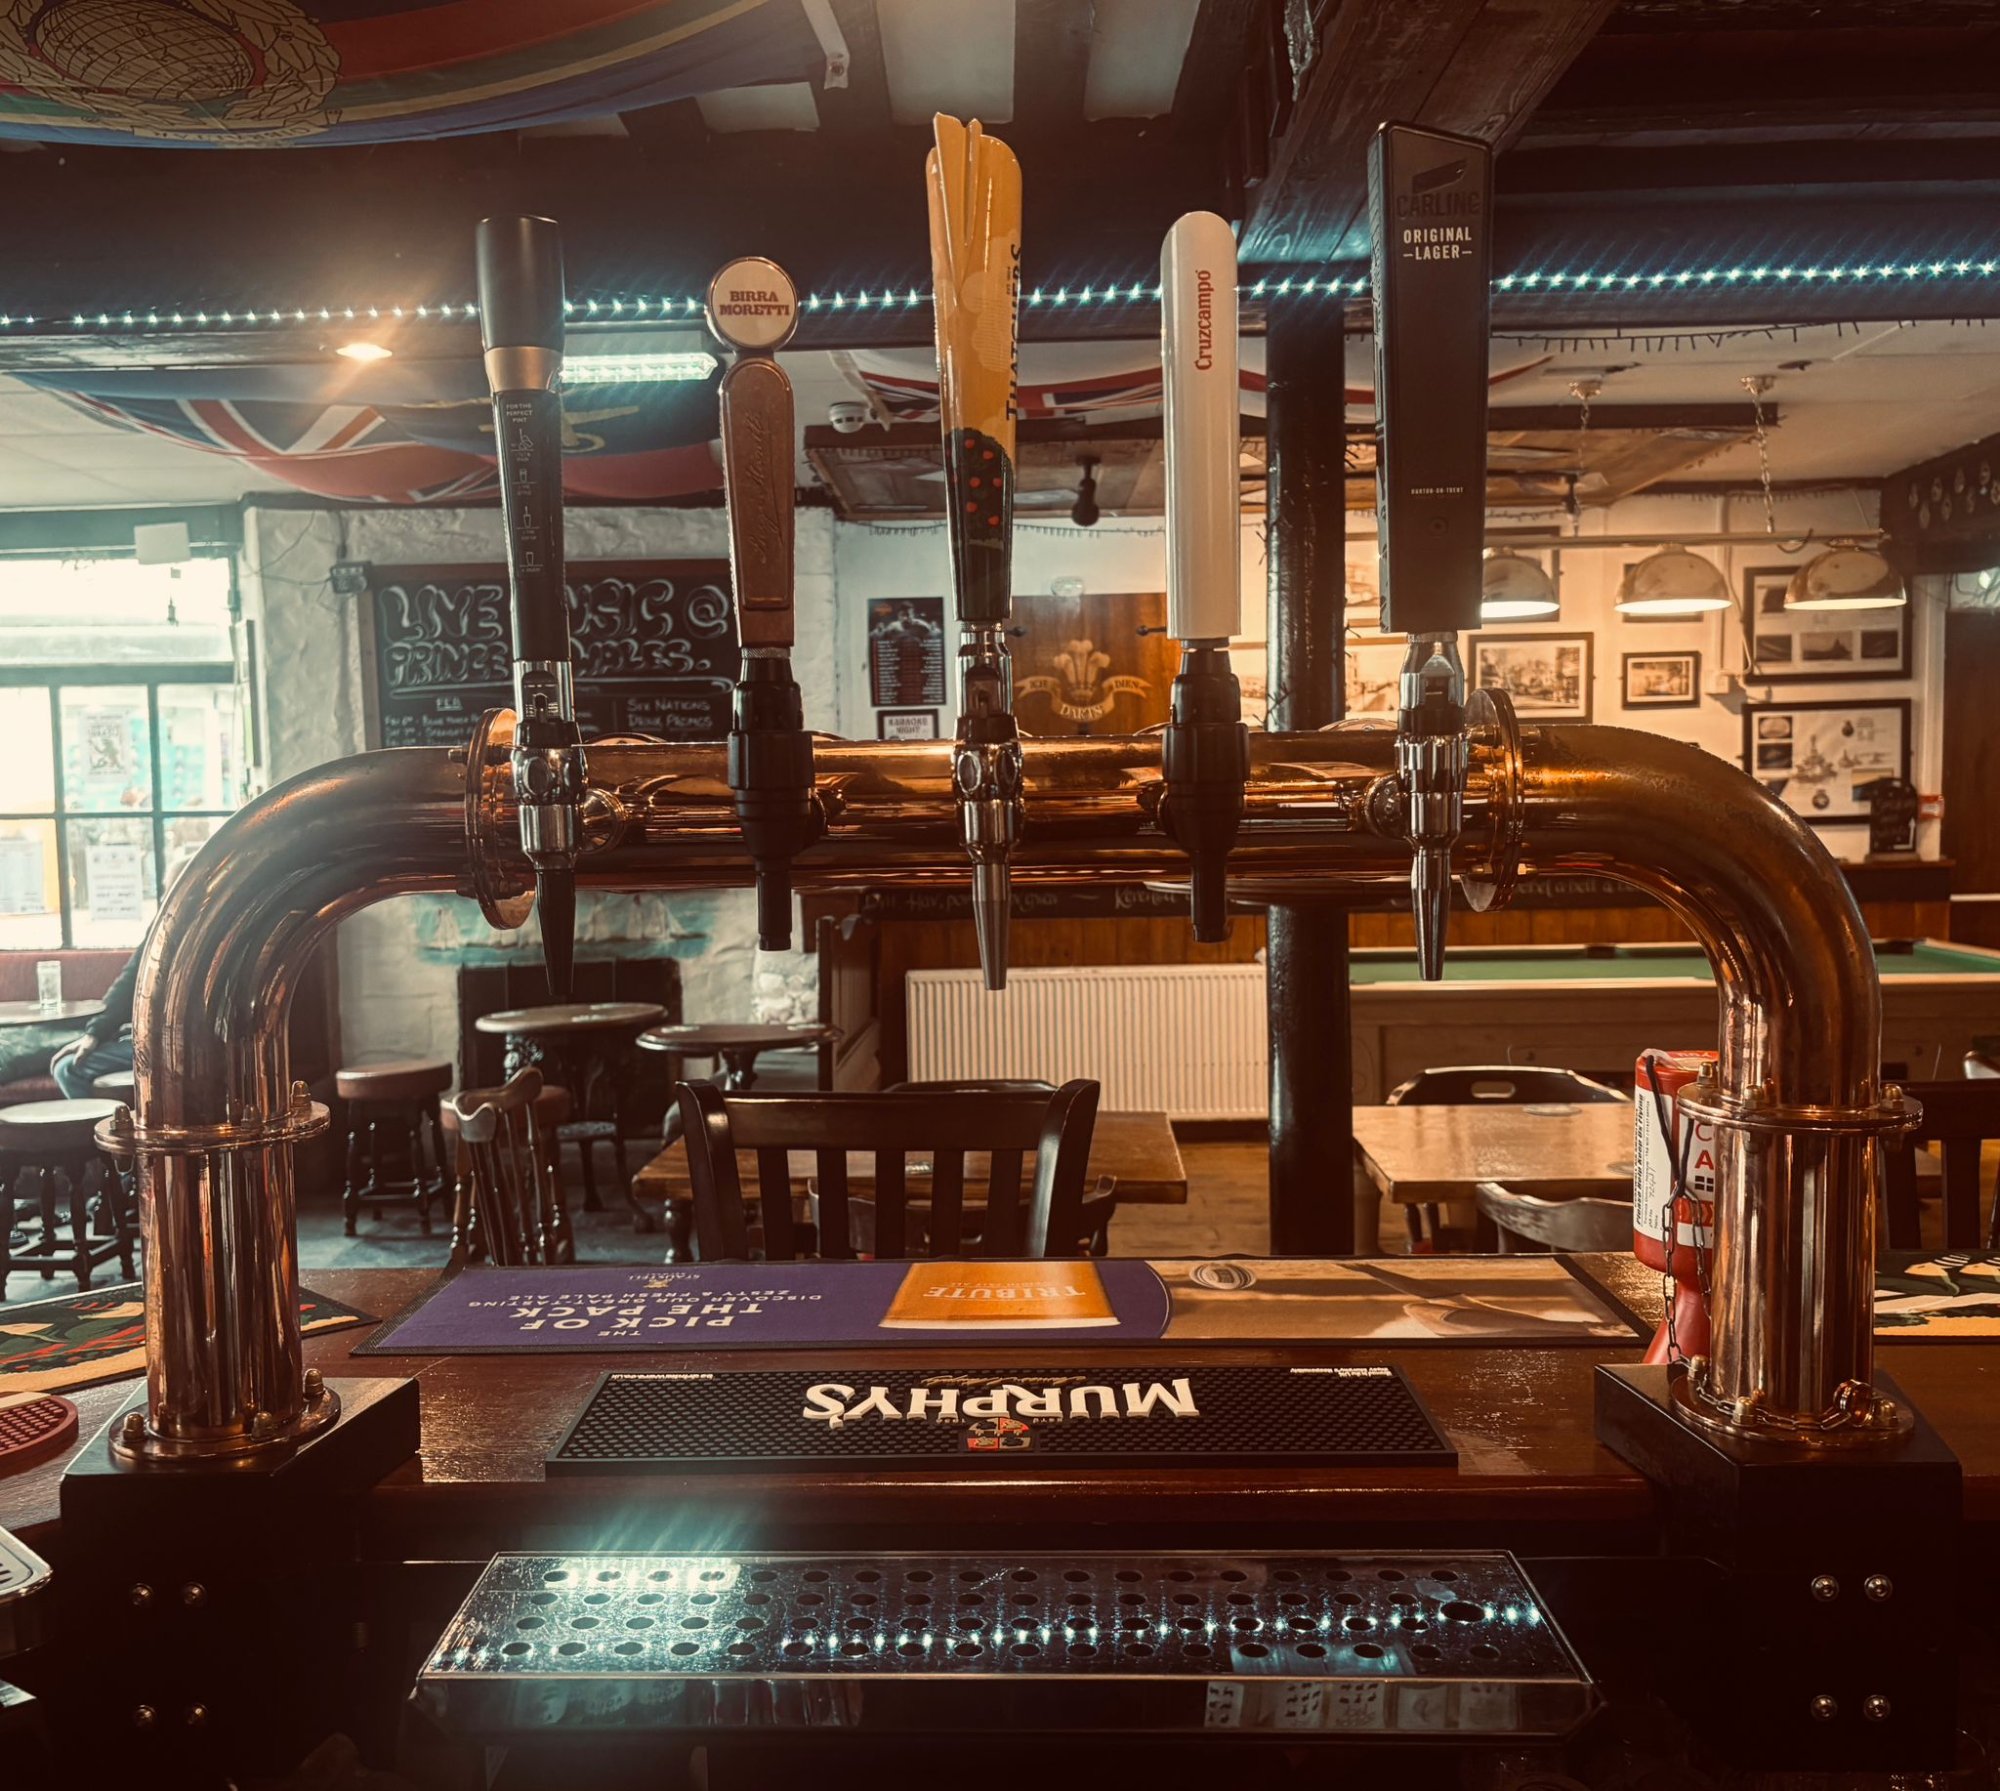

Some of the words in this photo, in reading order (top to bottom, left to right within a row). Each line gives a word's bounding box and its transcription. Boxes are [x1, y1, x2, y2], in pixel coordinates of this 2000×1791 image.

[1396, 191, 1482, 218] CARLING
[1403, 226, 1472, 244] ORIGINAL
[1415, 244, 1460, 261] LAGER
[729, 291, 779, 303] BIRRA
[719, 304, 790, 316] MORETTI
[1195, 269, 1214, 371] Cruzcampo
[379, 583, 504, 643] LIVE
[565, 577, 675, 638] USIC
[684, 584, 729, 640] @
[384, 640, 509, 687] PRINCE
[1114, 679, 1140, 689] DIEN
[626, 698, 650, 712] SIX
[655, 698, 711, 712] NATIONS
[1060, 704, 1104, 720] DARTS
[629, 715, 662, 728] DRINK
[666, 715, 712, 727] PROMOS
[888, 717, 928, 727] KARAOKE
[896, 726, 921, 734] NIGHT
[558, 1292, 613, 1300] PALE
[710, 1294, 822, 1303] DISCOVER
[921, 1285, 1086, 1300] TRIBUTE
[468, 1297, 645, 1307] GREAT-TASTING
[667, 1302, 763, 1314] THE
[508, 1305, 645, 1318] PACK
[519, 1318, 591, 1330] OF
[615, 1315, 735, 1329] PICK
[597, 1329, 642, 1337] THE
[800, 1378, 1200, 1430] MURPHY'S
